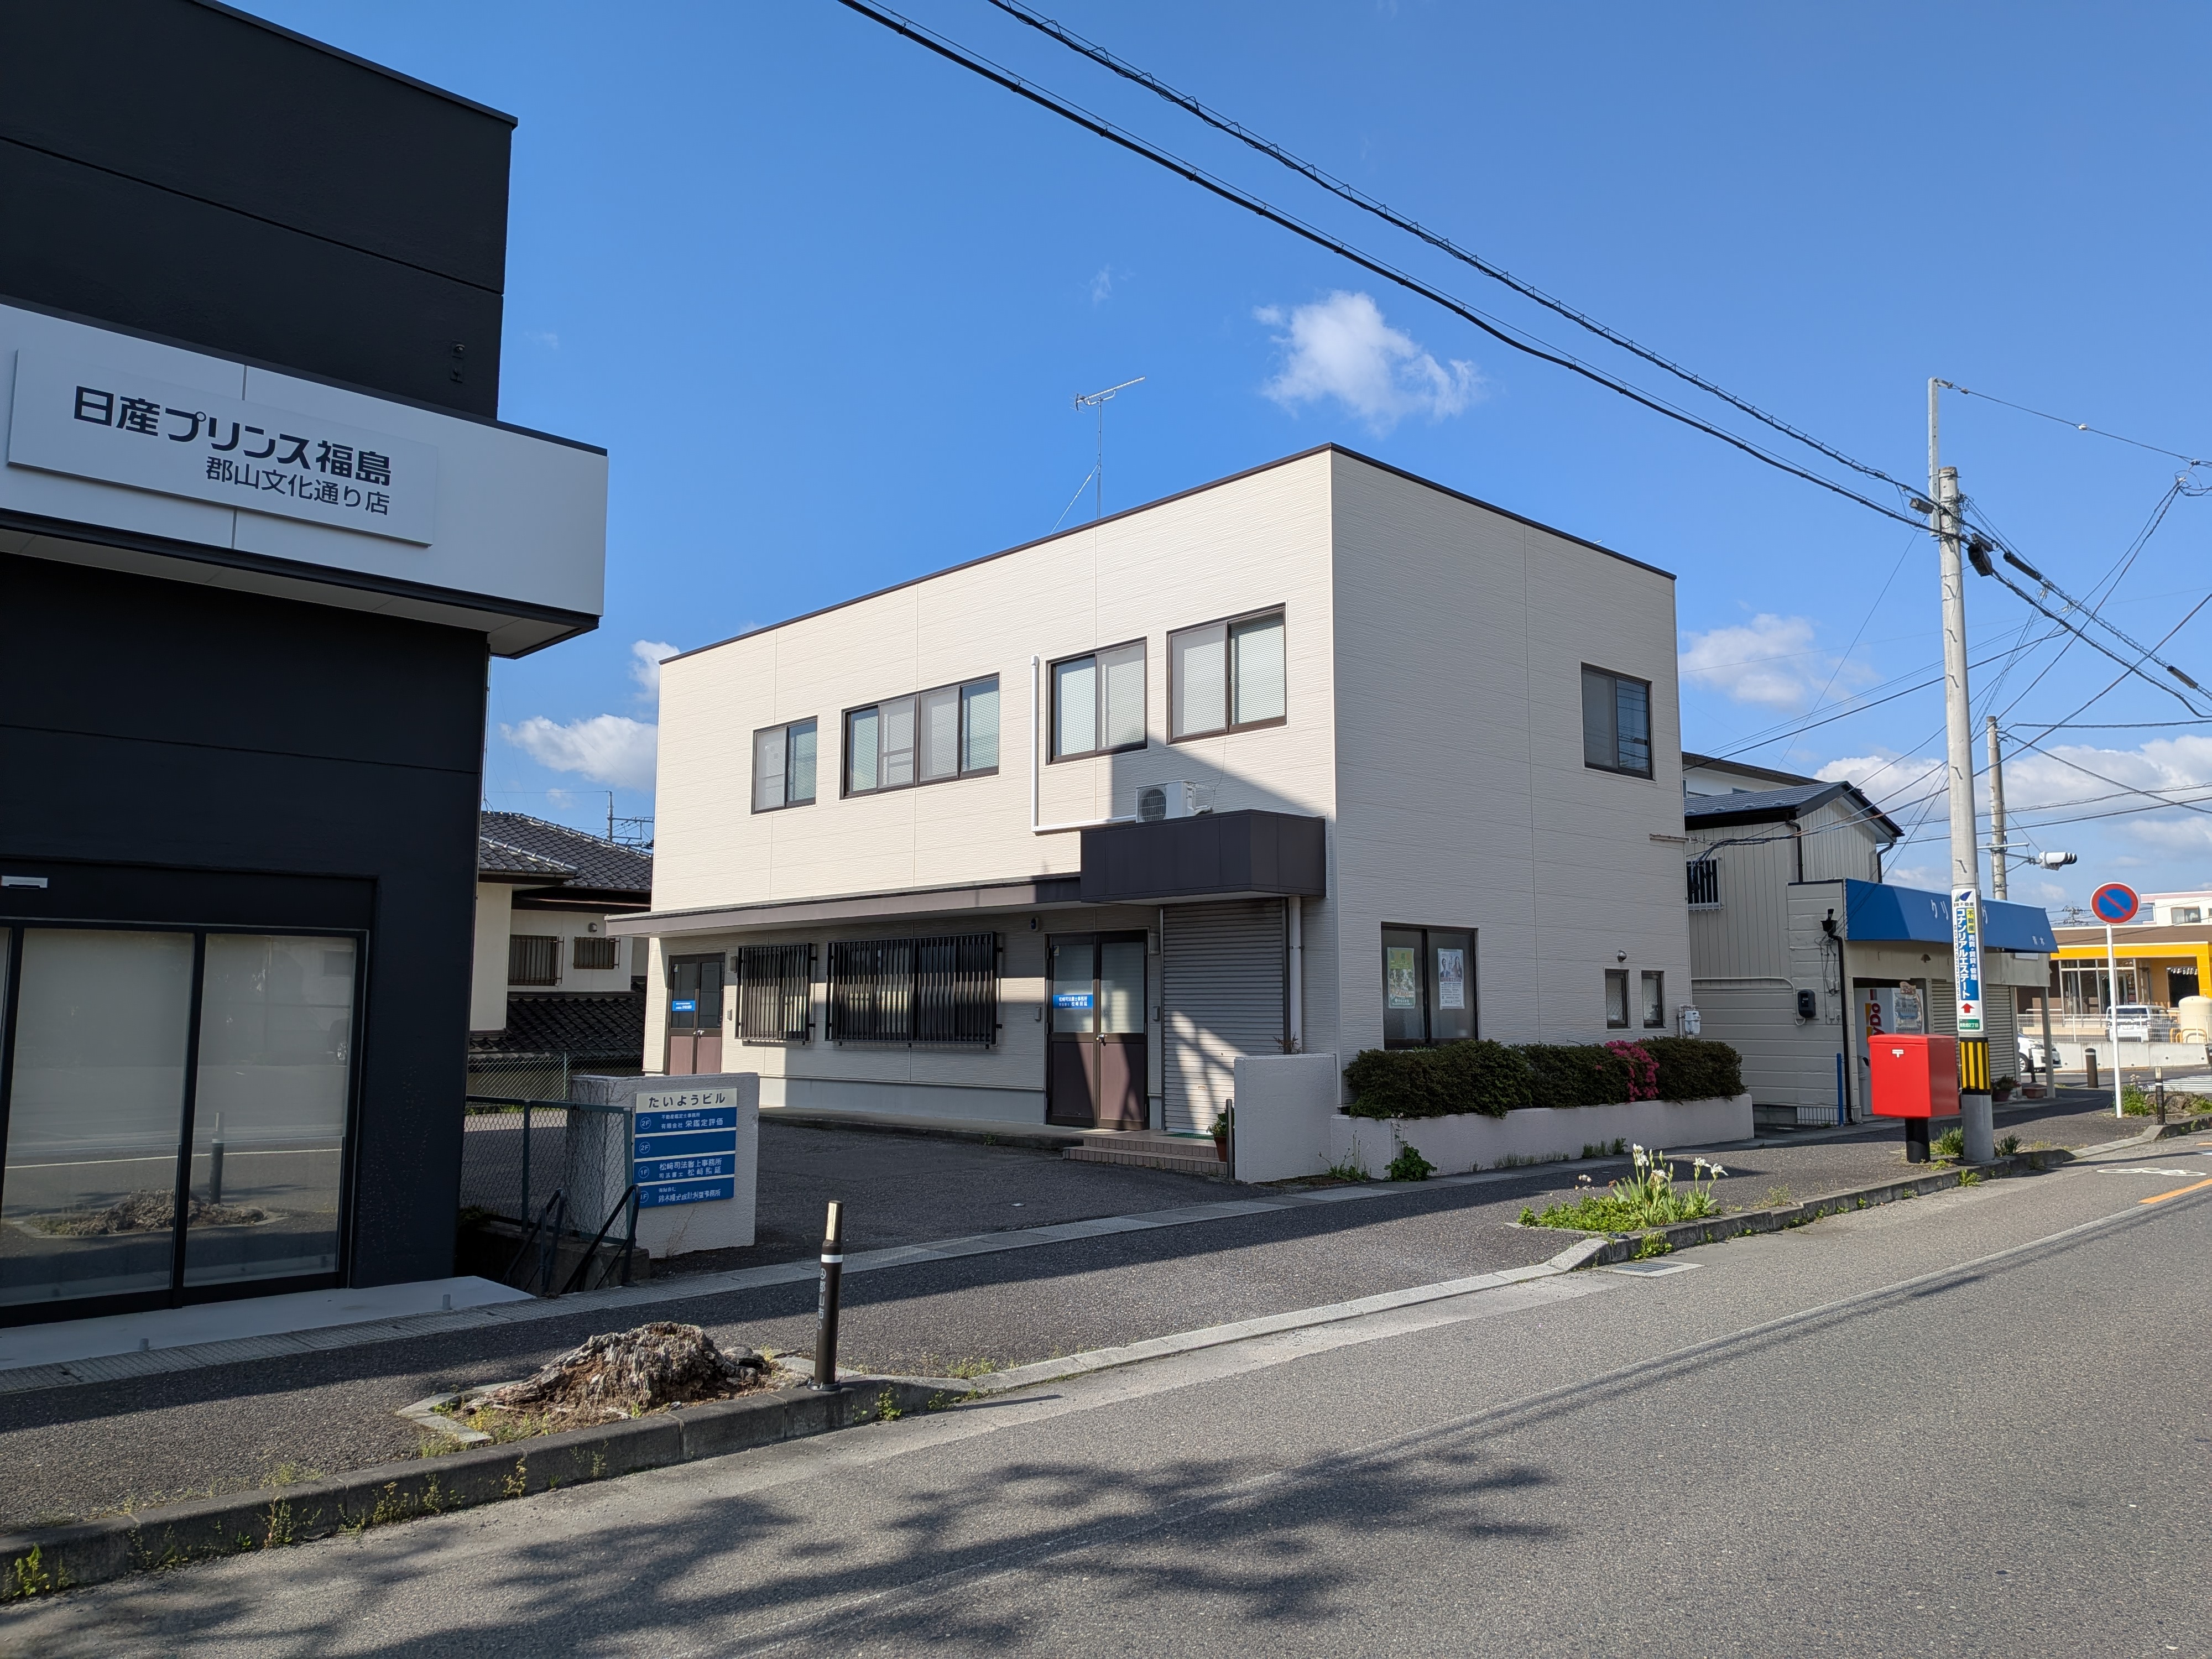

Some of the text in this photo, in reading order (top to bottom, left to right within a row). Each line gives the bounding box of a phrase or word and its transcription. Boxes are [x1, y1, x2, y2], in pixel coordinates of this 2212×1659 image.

[74, 385, 392, 486] 日産プリンス福島
[206, 457, 390, 515] 郡山文化通り店
[1957, 909, 1970, 999] コナンリアルエステート
[648, 1093, 726, 1108] たいようビル
[685, 1118, 723, 1128] 栄鑑定評価
